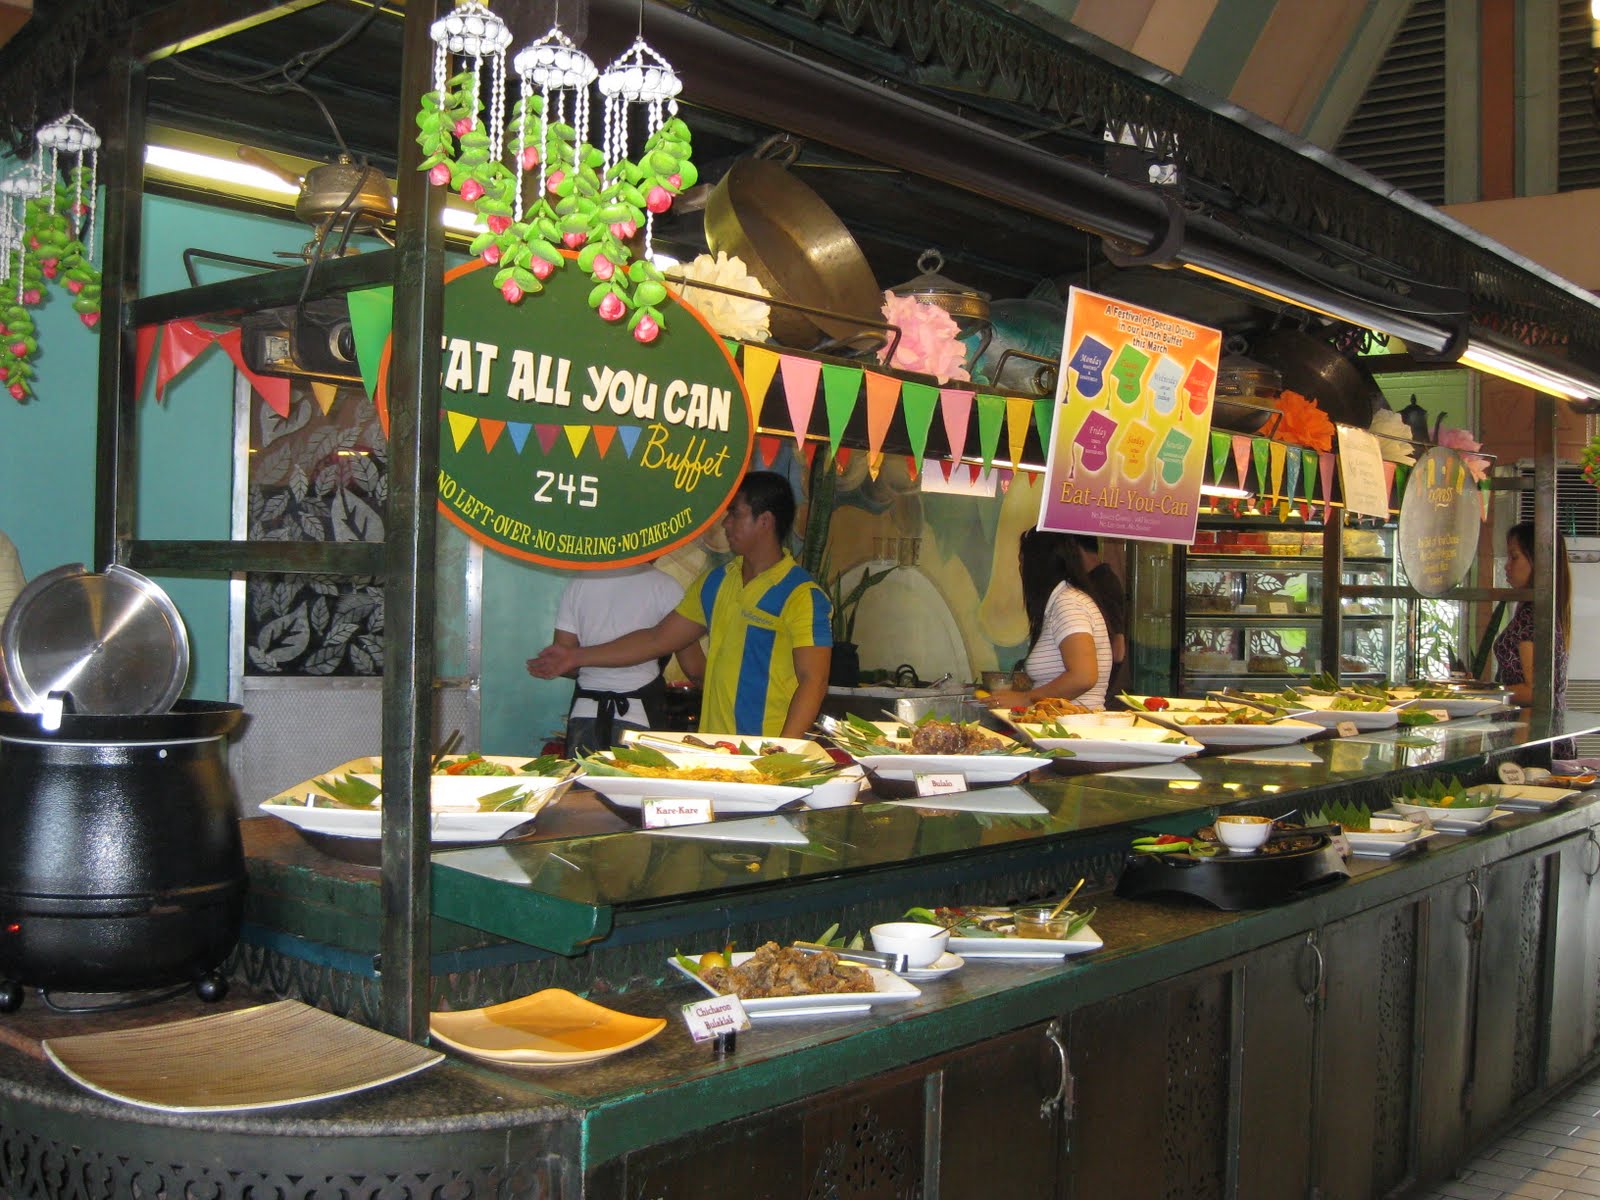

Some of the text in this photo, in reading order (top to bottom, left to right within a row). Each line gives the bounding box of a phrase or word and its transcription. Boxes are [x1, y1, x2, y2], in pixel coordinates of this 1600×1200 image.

[1114, 307, 1141, 323] Festival
[1143, 316, 1150, 325] of
[1151, 318, 1174, 332] Special
[1176, 324, 1195, 339] Dishes
[1119, 322, 1182, 346] in our Lunch Buffet
[1132, 337, 1168, 354] this March
[441, 335, 732, 432] AT ALL YOU CAN
[1089, 426, 1107, 439] Friday
[640, 422, 731, 493] Buffet
[534, 470, 599, 508] 245
[1060, 481, 1189, 517] Eat-All-You-Can
[437, 469, 457, 499] NO
[534, 529, 556, 551] NO
[557, 533, 616, 556] SHARING
[622, 532, 639, 552] NO
[931, 779, 953, 788] Bulalo
[656, 806, 699, 815] Kare-Kare
[695, 1003, 732, 1017] Chicharon
[704, 1015, 735, 1030] Bulaklak
